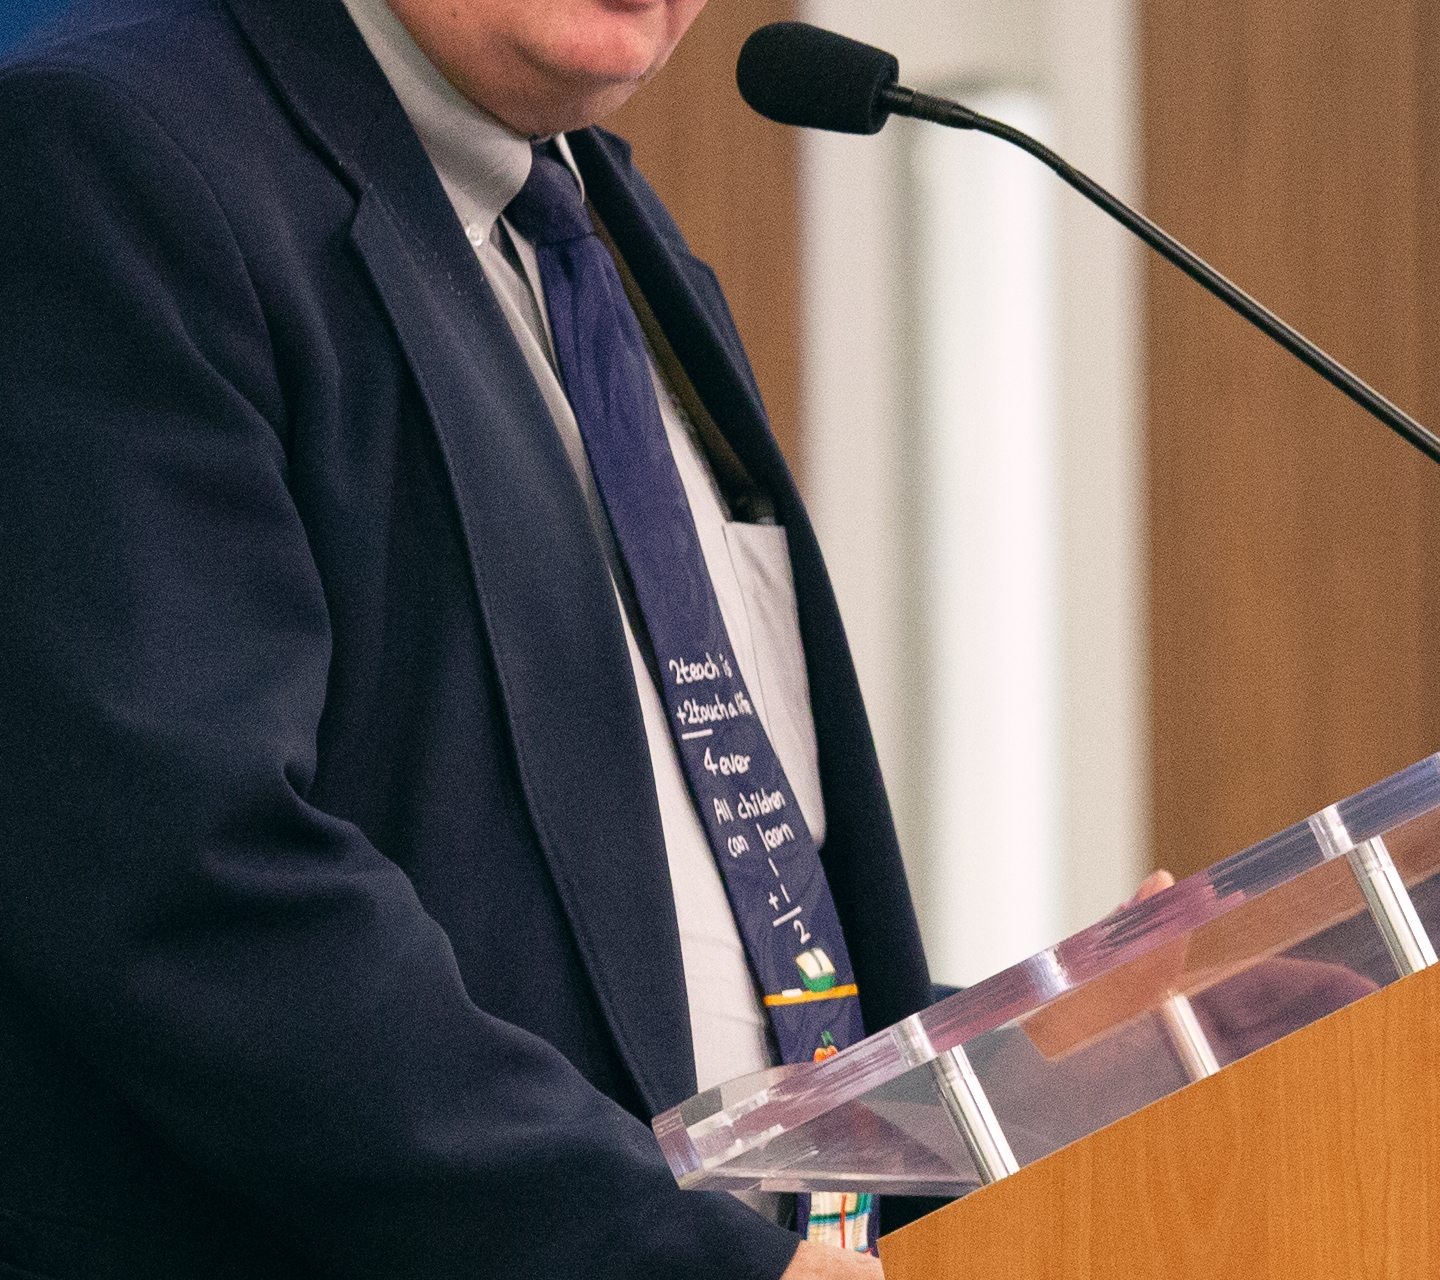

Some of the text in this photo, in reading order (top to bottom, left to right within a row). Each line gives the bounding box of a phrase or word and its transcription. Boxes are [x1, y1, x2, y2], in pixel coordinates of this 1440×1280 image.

[713, 788, 786, 825] All children
[727, 823, 795, 858] can learn
[793, 921, 812, 945] 2
